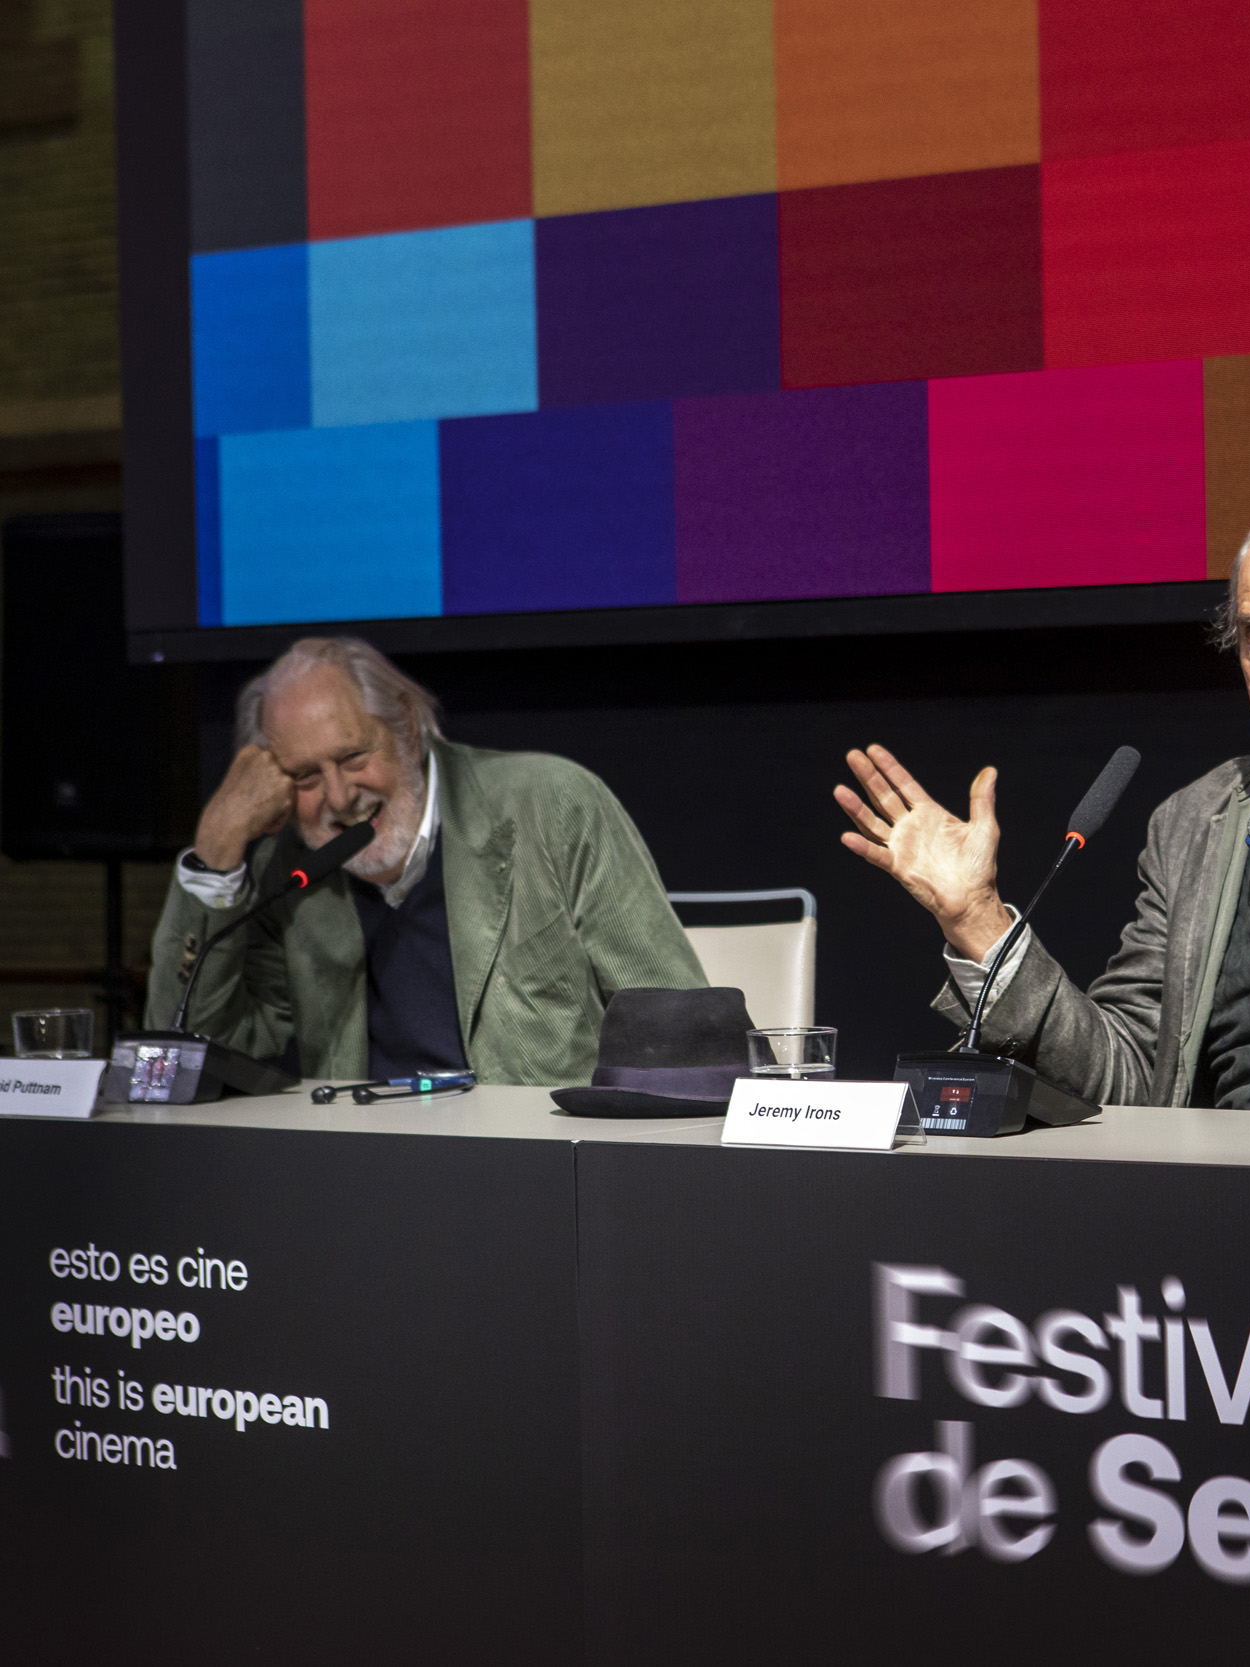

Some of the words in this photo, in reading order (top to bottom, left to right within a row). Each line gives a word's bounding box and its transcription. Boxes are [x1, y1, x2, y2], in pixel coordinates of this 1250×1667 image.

[12, 1079, 62, 1095] Puttnam
[748, 1102, 803, 1122] Jeremy
[804, 1104, 842, 1121] Irons
[49, 1242, 121, 1282] esto
[128, 1253, 169, 1286] es
[176, 1246, 249, 1292] cine
[50, 1302, 201, 1350] europeo
[51, 1365, 111, 1409] this
[117, 1369, 145, 1412] is
[151, 1383, 330, 1433] european
[54, 1420, 178, 1470] cinema
[875, 1419, 1059, 1563] de
